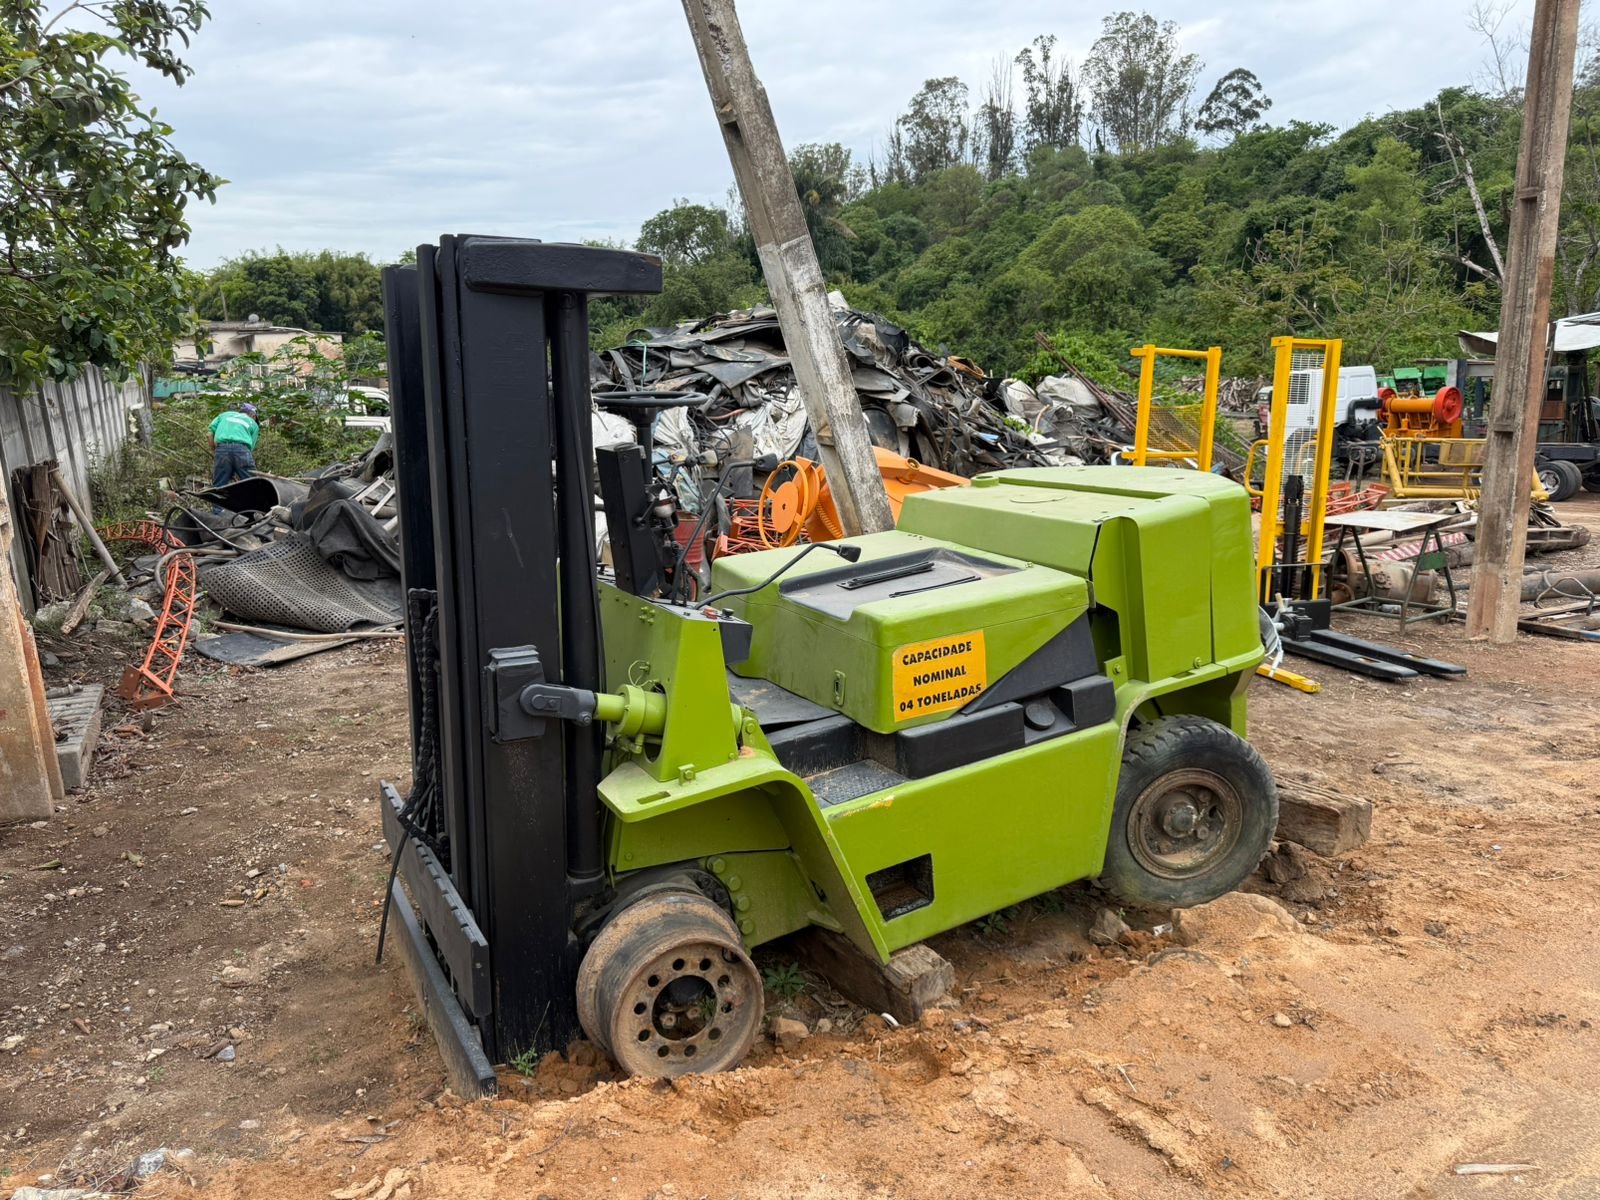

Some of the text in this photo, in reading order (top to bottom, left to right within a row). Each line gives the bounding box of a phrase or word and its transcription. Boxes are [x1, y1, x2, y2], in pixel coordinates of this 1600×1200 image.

[902, 641, 972, 665] CAPACIDADE
[913, 665, 966, 686] NOMINAL
[899, 683, 982, 712] 04 TONELADAS
